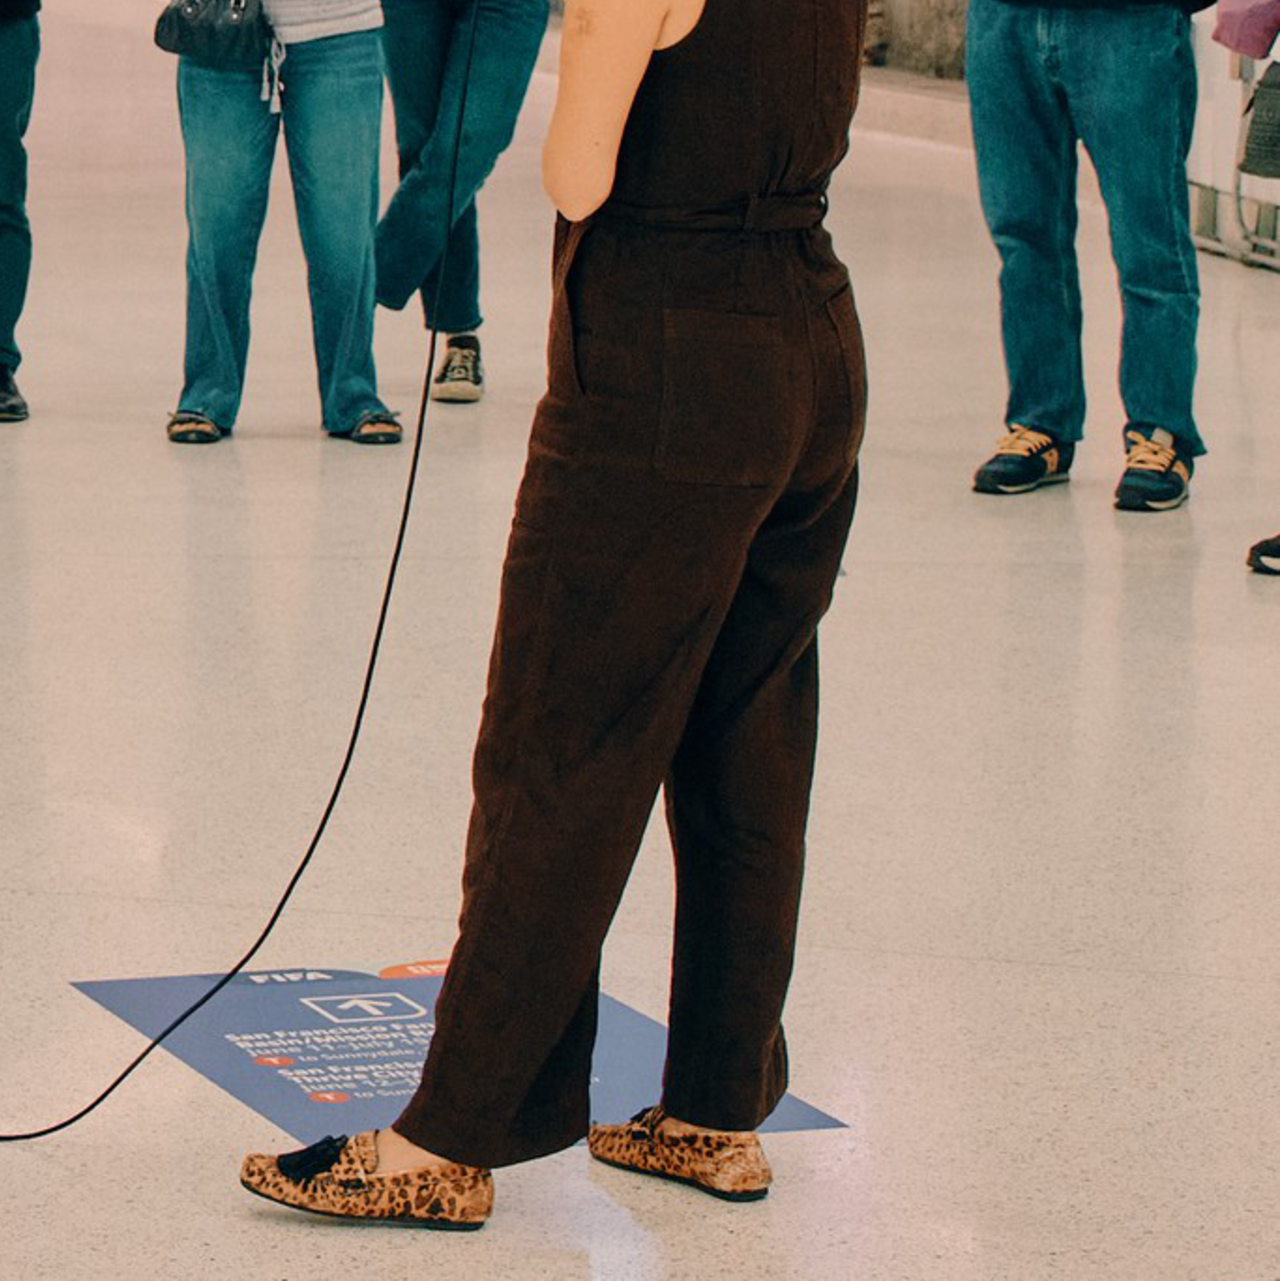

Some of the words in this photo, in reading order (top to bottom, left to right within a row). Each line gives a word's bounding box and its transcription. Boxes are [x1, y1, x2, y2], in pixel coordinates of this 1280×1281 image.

[249, 972, 333, 984] FIFA
[224, 1033, 271, 1041] San
[273, 1026, 388, 1037] Francisco
[277, 1066, 326, 1076] San
